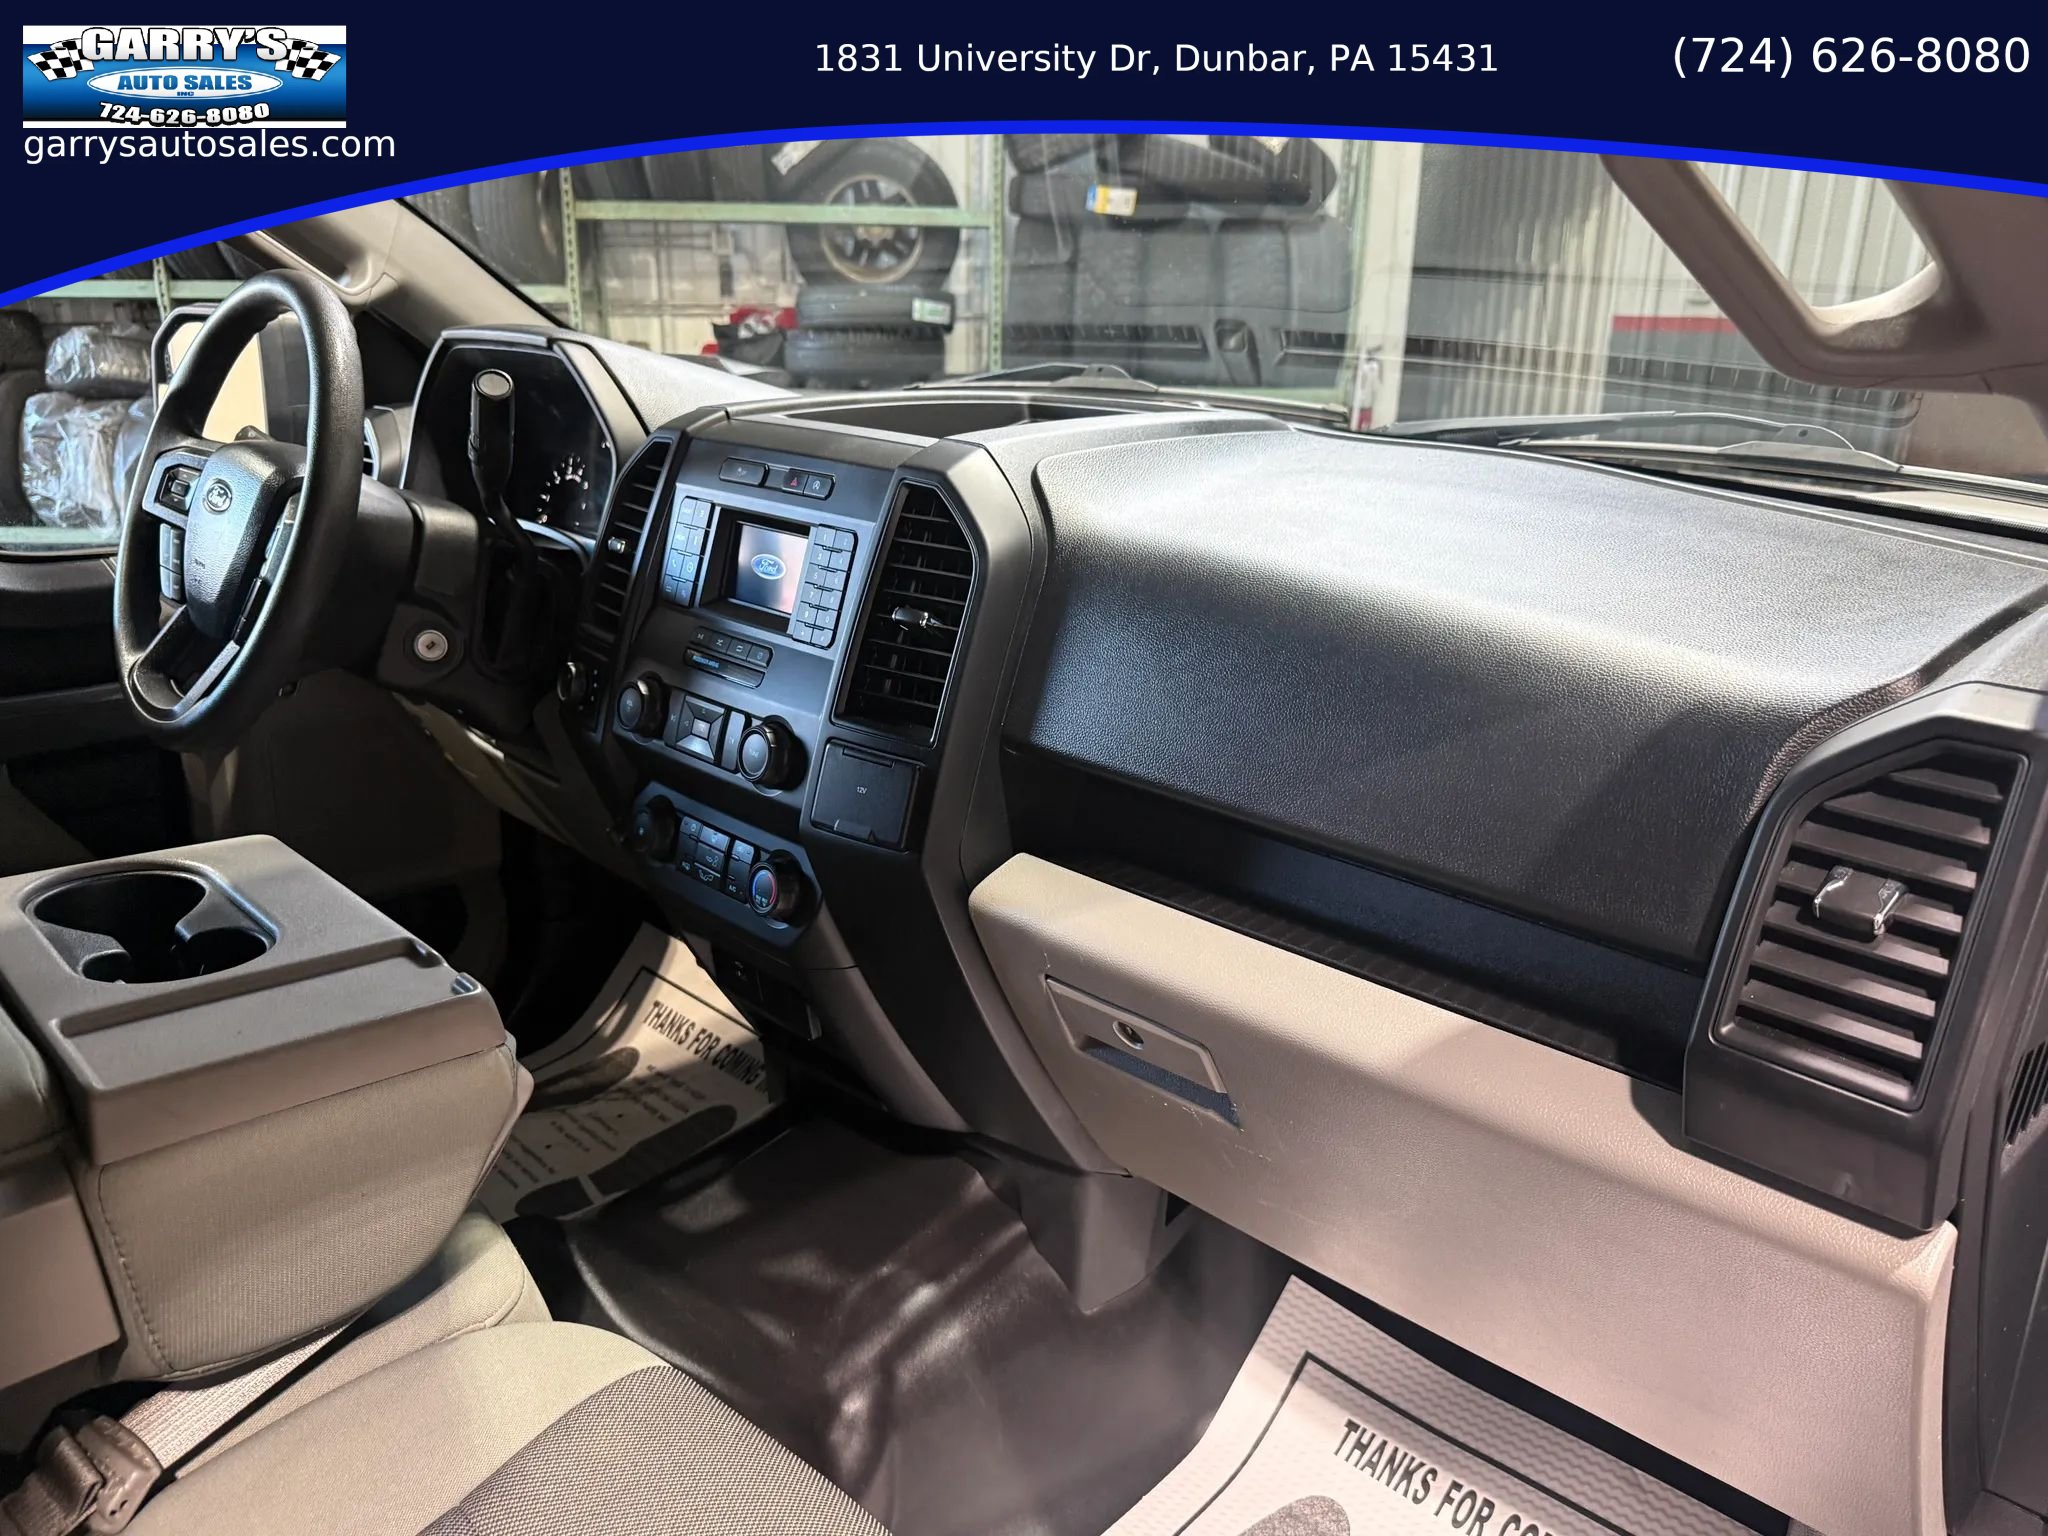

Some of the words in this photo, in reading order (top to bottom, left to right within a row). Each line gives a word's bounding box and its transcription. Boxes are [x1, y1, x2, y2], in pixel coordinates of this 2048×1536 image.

[643, 1000, 696, 1045] THANKS
[686, 1027, 721, 1060] FOR
[1333, 1418, 1438, 1505] THANKS
[1433, 1480, 1495, 1536] FOR
